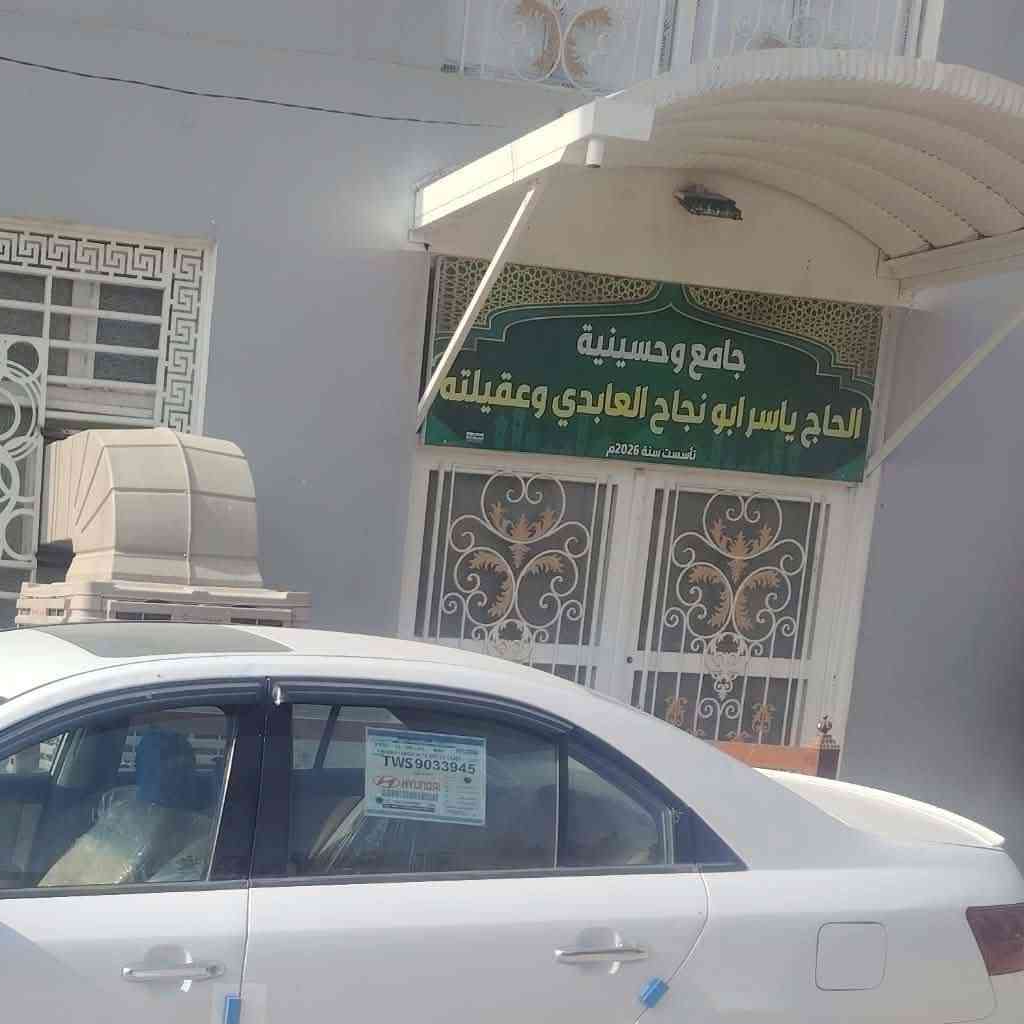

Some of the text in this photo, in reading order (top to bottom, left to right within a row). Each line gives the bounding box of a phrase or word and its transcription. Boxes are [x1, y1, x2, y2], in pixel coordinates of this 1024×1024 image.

[576, 323, 746, 381] جامع وحسينية
[439, 369, 863, 448] الحاج ياسر ابو نجاح العابدي وعقيلته
